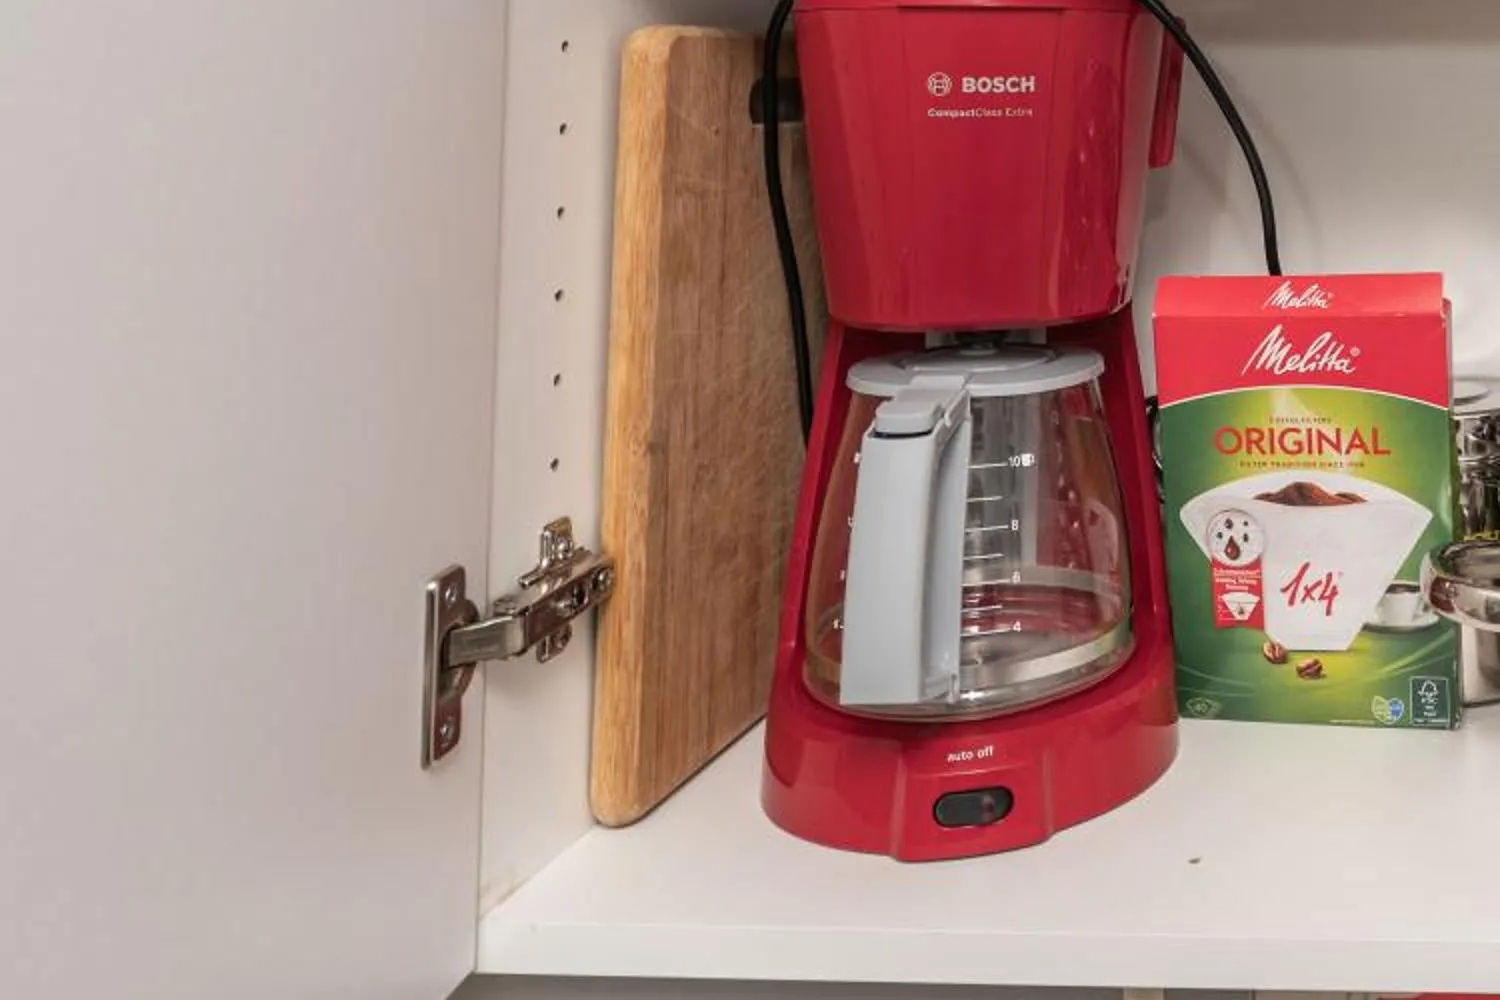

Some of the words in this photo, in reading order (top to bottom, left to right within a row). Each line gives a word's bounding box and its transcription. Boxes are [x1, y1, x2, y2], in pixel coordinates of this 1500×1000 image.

[961, 76, 1036, 93] BOSCH
[927, 107, 1003, 118] CompactClass
[1005, 107, 1033, 117] Extra
[1262, 280, 1331, 310] Melitta
[1241, 323, 1356, 376] Melitta
[1214, 426, 1392, 456] ORIGINAL
[1279, 561, 1341, 617] 1x4
[946, 750, 975, 763] auto
[977, 744, 995, 759] off
